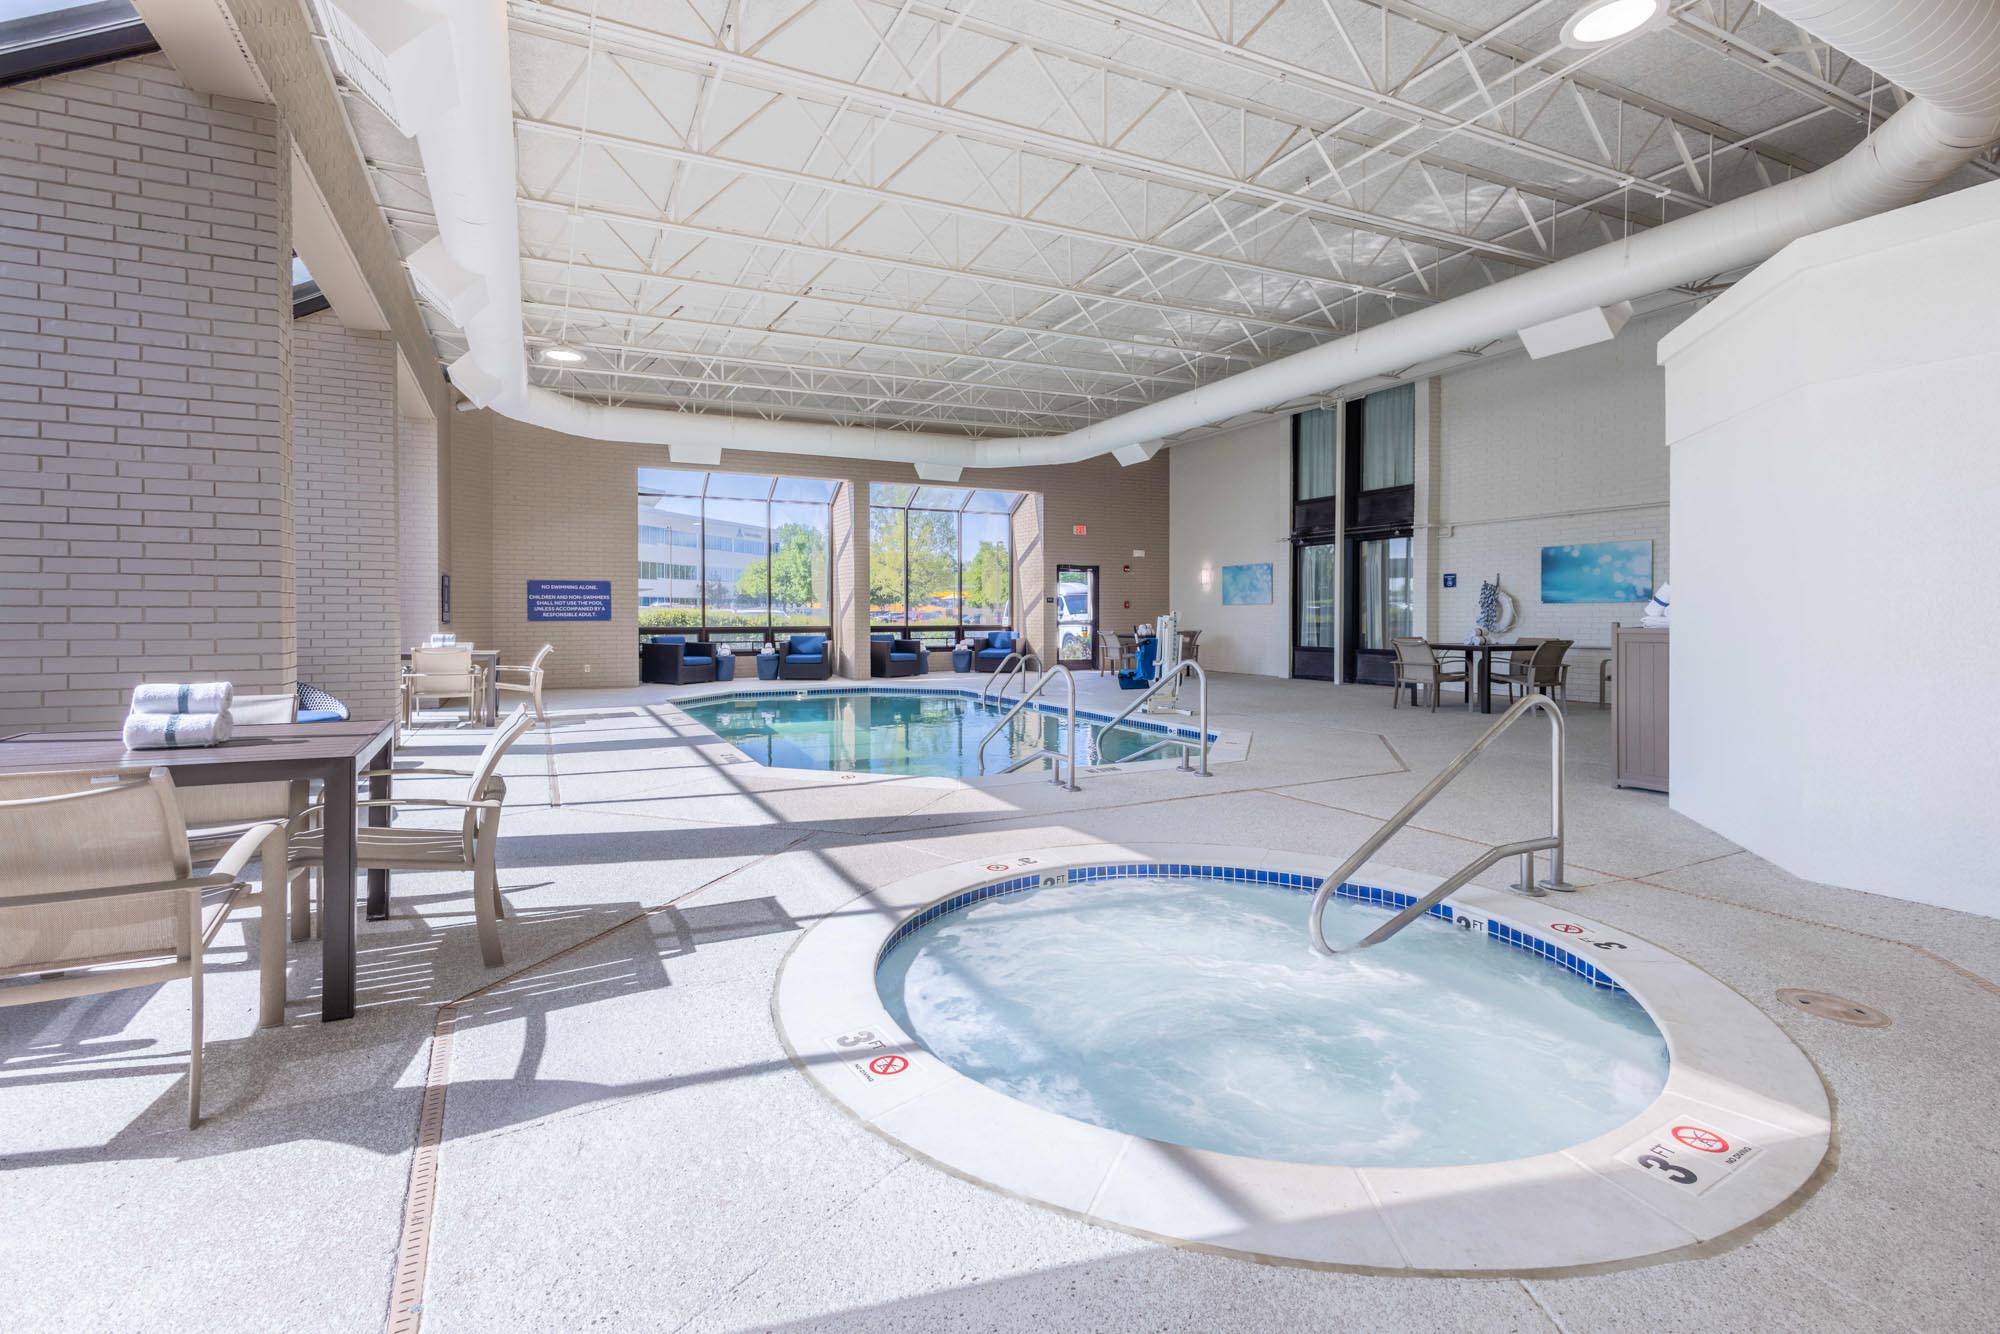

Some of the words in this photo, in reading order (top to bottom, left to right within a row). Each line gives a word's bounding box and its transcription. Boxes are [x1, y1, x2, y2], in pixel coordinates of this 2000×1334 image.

[1056, 874, 1066, 884] FT
[1472, 919, 1484, 931] FT
[836, 1030, 875, 1047] 3
[868, 1040, 887, 1050] FT
[1650, 1144, 1675, 1158] FT
[1733, 1146, 1752, 1159] DIVING
[1638, 1154, 1698, 1185] 3
